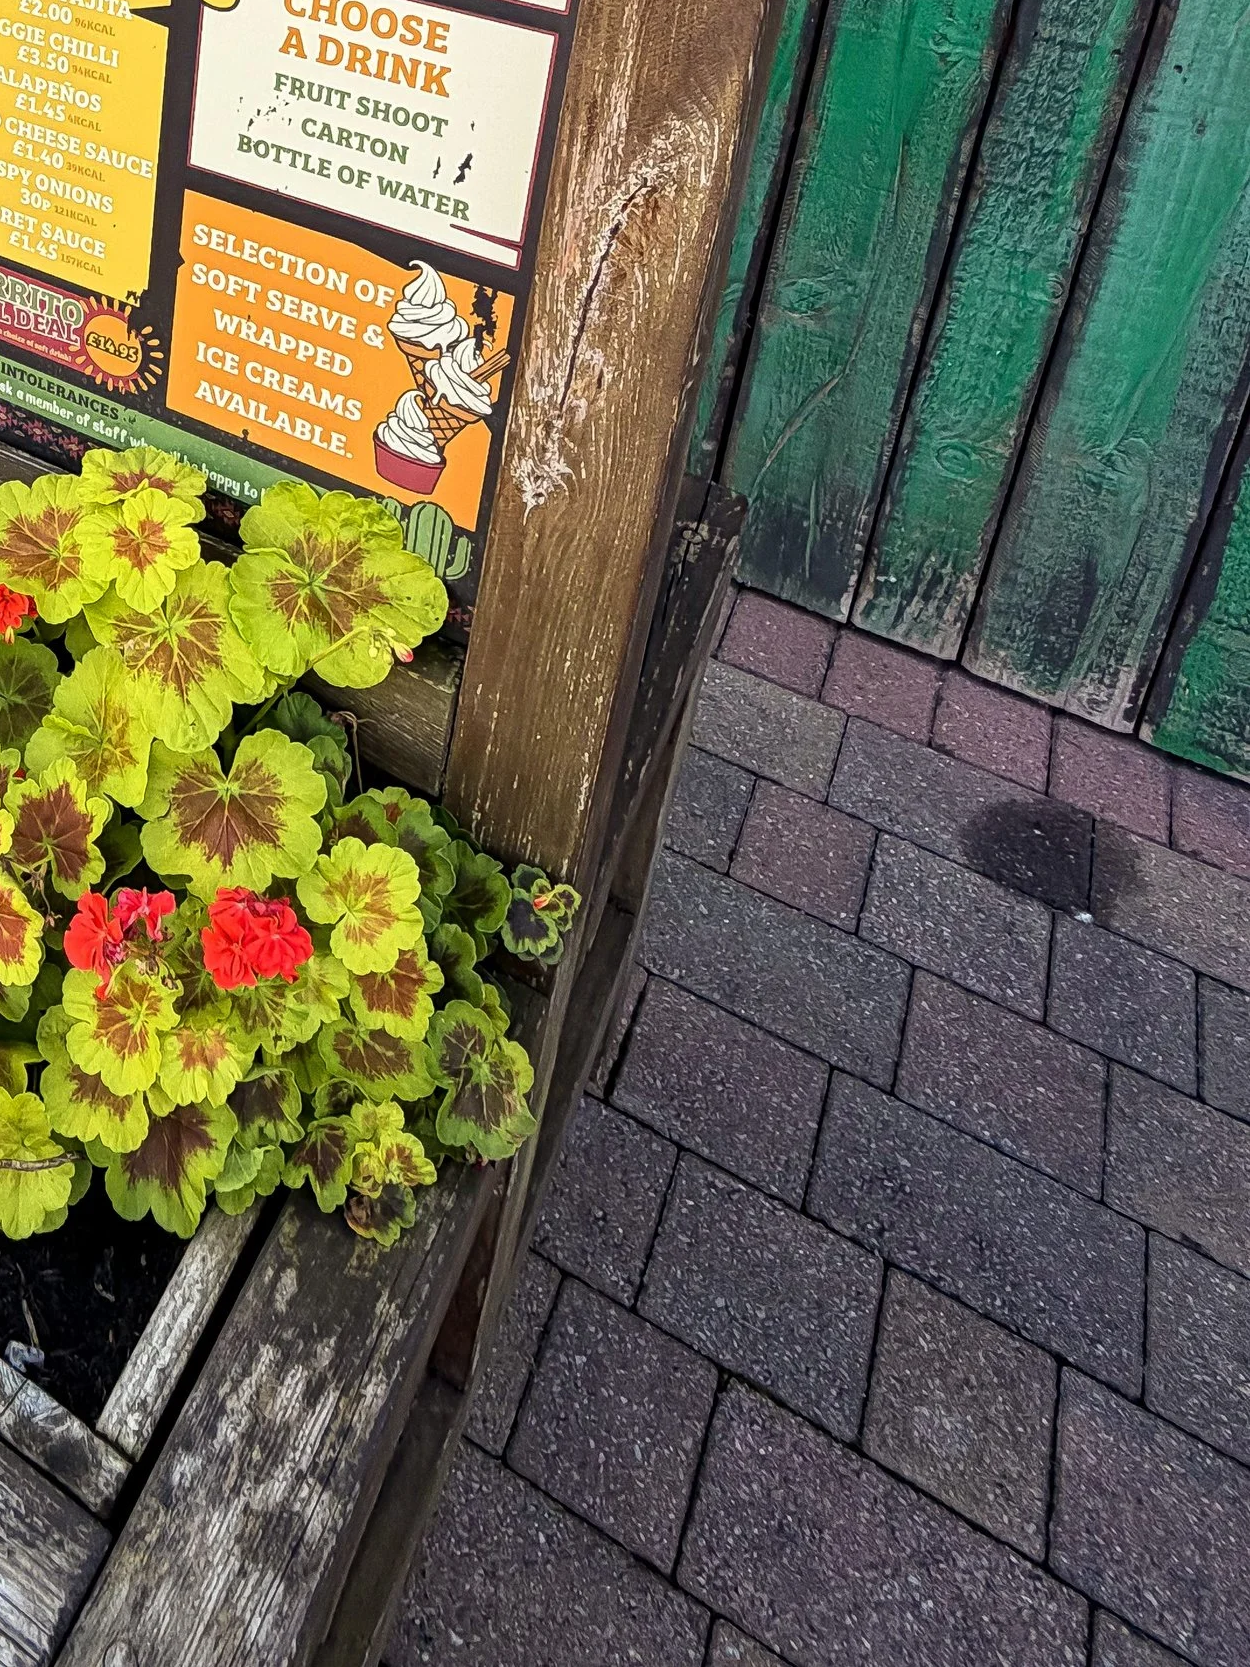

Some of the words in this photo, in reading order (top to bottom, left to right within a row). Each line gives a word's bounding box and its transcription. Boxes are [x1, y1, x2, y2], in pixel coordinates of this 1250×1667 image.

[17, 46, 69, 74] £3.50
[49, 33, 120, 68] CHILLI
[279, 26, 307, 59] A
[315, 34, 452, 98] DRINK
[15, 93, 66, 123] £1.45
[274, 72, 351, 110] FRUIT
[355, 96, 449, 137] SHOOT
[5, 117, 81, 156] CHEESE
[85, 141, 154, 179] SAUCE
[12, 140, 64, 170] £1.40
[301, 118, 410, 165] CARTON
[35, 173, 114, 214] ONIONS
[237, 134, 331, 179] BOTTLE
[337, 164, 372, 190] OF
[377, 175, 470, 221] WATER
[9, 233, 58, 261] £1.45
[41, 222, 107, 259] SAUCE
[192, 223, 350, 295] SELECTION
[354, 279, 396, 309] OF
[14, 310, 81, 347] DEAL
[191, 263, 261, 304] SOFT
[266, 289, 357, 340] SERVE
[361, 324, 385, 350] &
[87, 333, 138, 362] £14.95
[212, 308, 353, 376] WRAPPED
[1, 362, 120, 420] INTOLERANCES
[195, 341, 241, 375] ICE
[244, 360, 362, 421] CREAMS
[26, 394, 73, 421] member
[195, 379, 354, 459] AVAILABLE.
